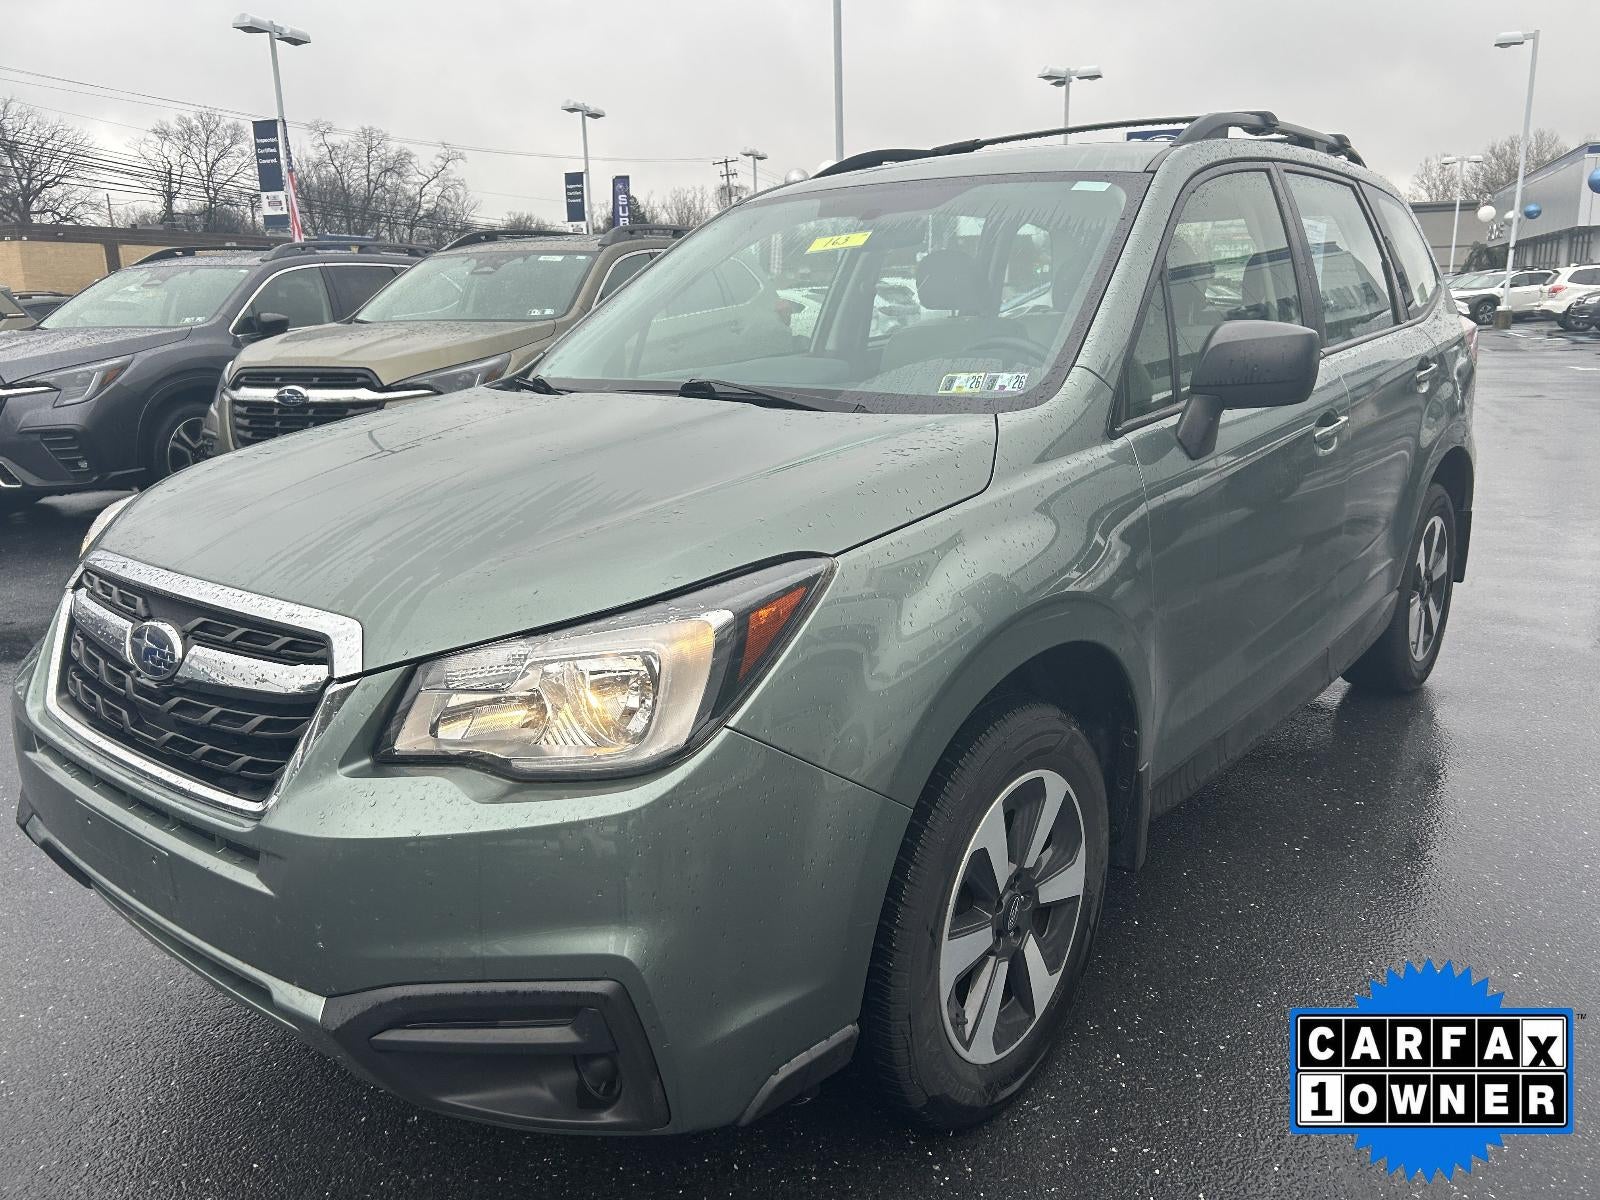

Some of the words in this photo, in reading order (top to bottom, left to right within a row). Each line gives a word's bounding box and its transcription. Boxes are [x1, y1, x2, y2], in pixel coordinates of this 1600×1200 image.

[823, 236, 851, 248] 163
[969, 375, 983, 389] 26
[1011, 375, 1026, 389] 26
